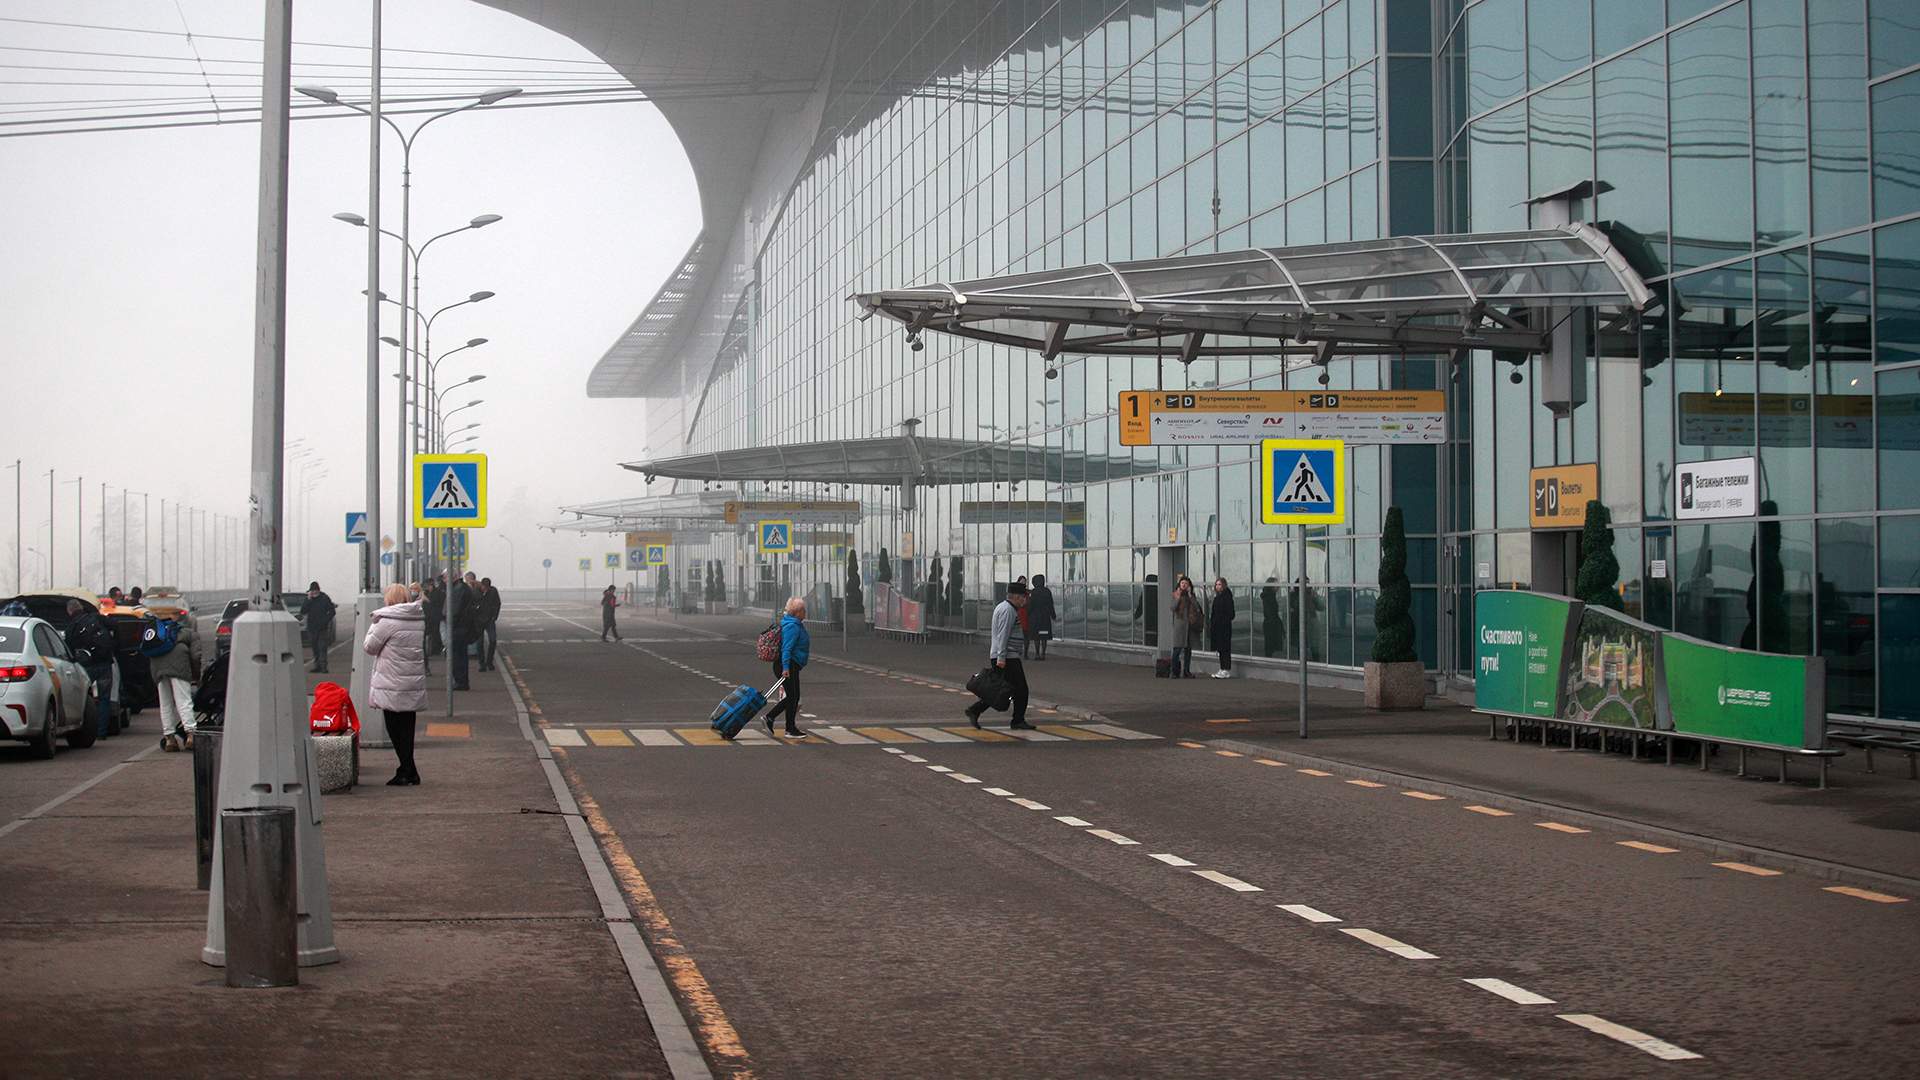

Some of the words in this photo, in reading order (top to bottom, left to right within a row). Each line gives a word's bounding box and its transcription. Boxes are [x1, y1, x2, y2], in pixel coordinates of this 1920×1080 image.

[1128, 395, 1138, 417] 1
[1184, 397, 1193, 406] D
[1328, 397, 1336, 406] D
[1696, 475, 1723, 489] Багажные
[1724, 475, 1748, 487] тележки
[1549, 485, 1556, 509] D
[728, 503, 736, 513] 2
[1481, 625, 1523, 645] Счастливого
[1481, 652, 1499, 676] пути!
[313, 719, 331, 728] PUMA
